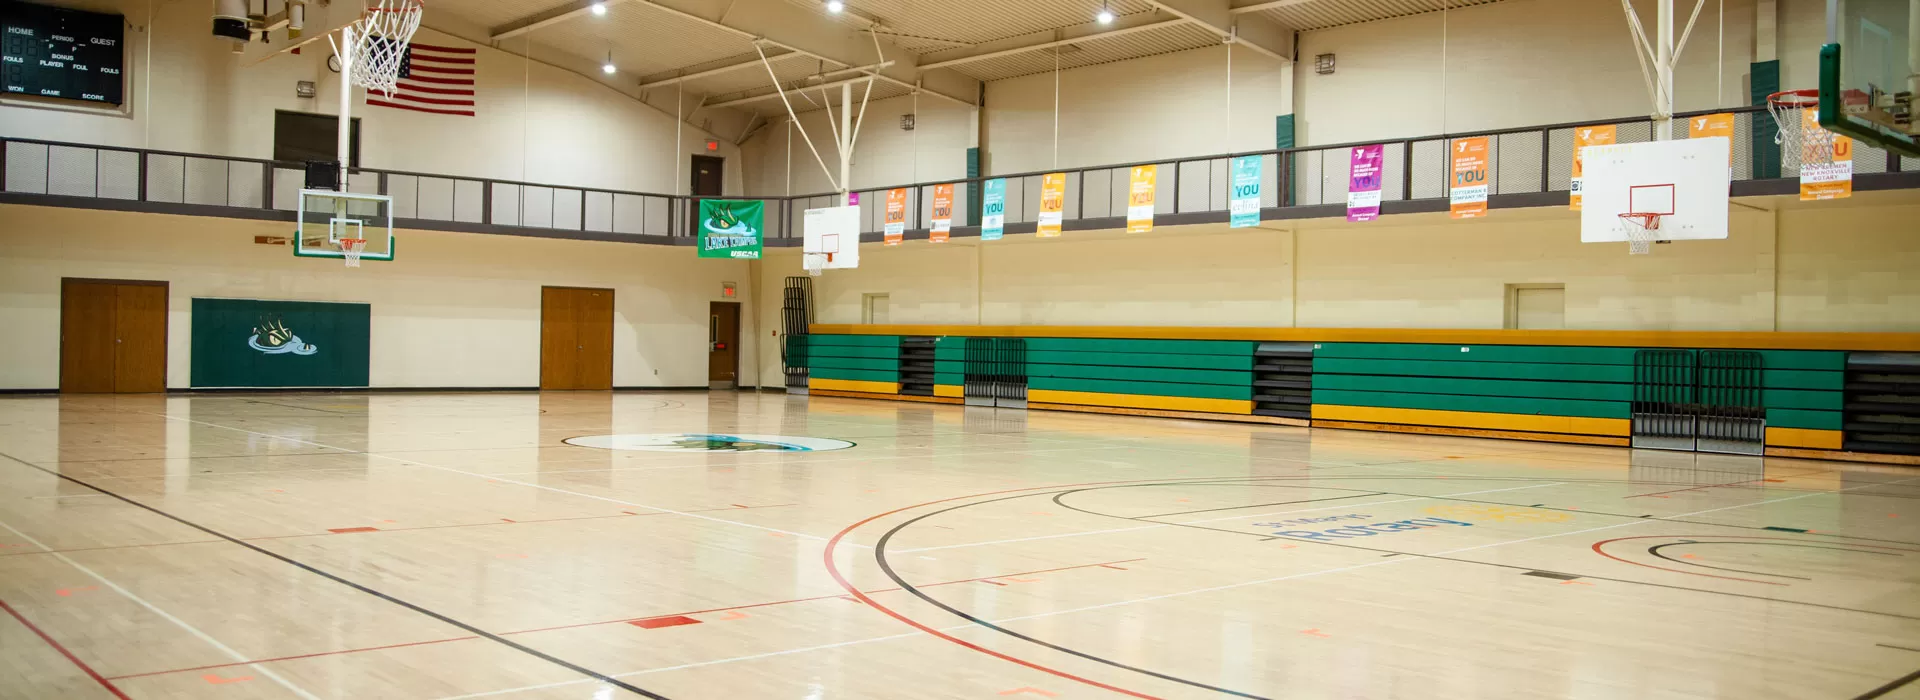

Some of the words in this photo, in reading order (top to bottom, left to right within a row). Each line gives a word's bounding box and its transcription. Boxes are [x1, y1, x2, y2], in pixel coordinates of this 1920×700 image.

[8, 26, 34, 36] HOME
[51, 34, 75, 43] PERIOD
[90, 37, 116, 46] GUEST
[3, 55, 24, 63] FOULS
[51, 53, 74, 61] BONUS
[39, 60, 64, 68] PLAYER
[100, 67, 119, 75] FOULS
[41, 88, 60, 96] GAME
[1354, 176, 1380, 188] YOU
[1456, 170, 1485, 185] YOU
[1236, 184, 1259, 198] YOU
[986, 203, 1003, 215] YOU
[704, 236, 728, 250] LAKE
[1272, 517, 1473, 542] Rotary
